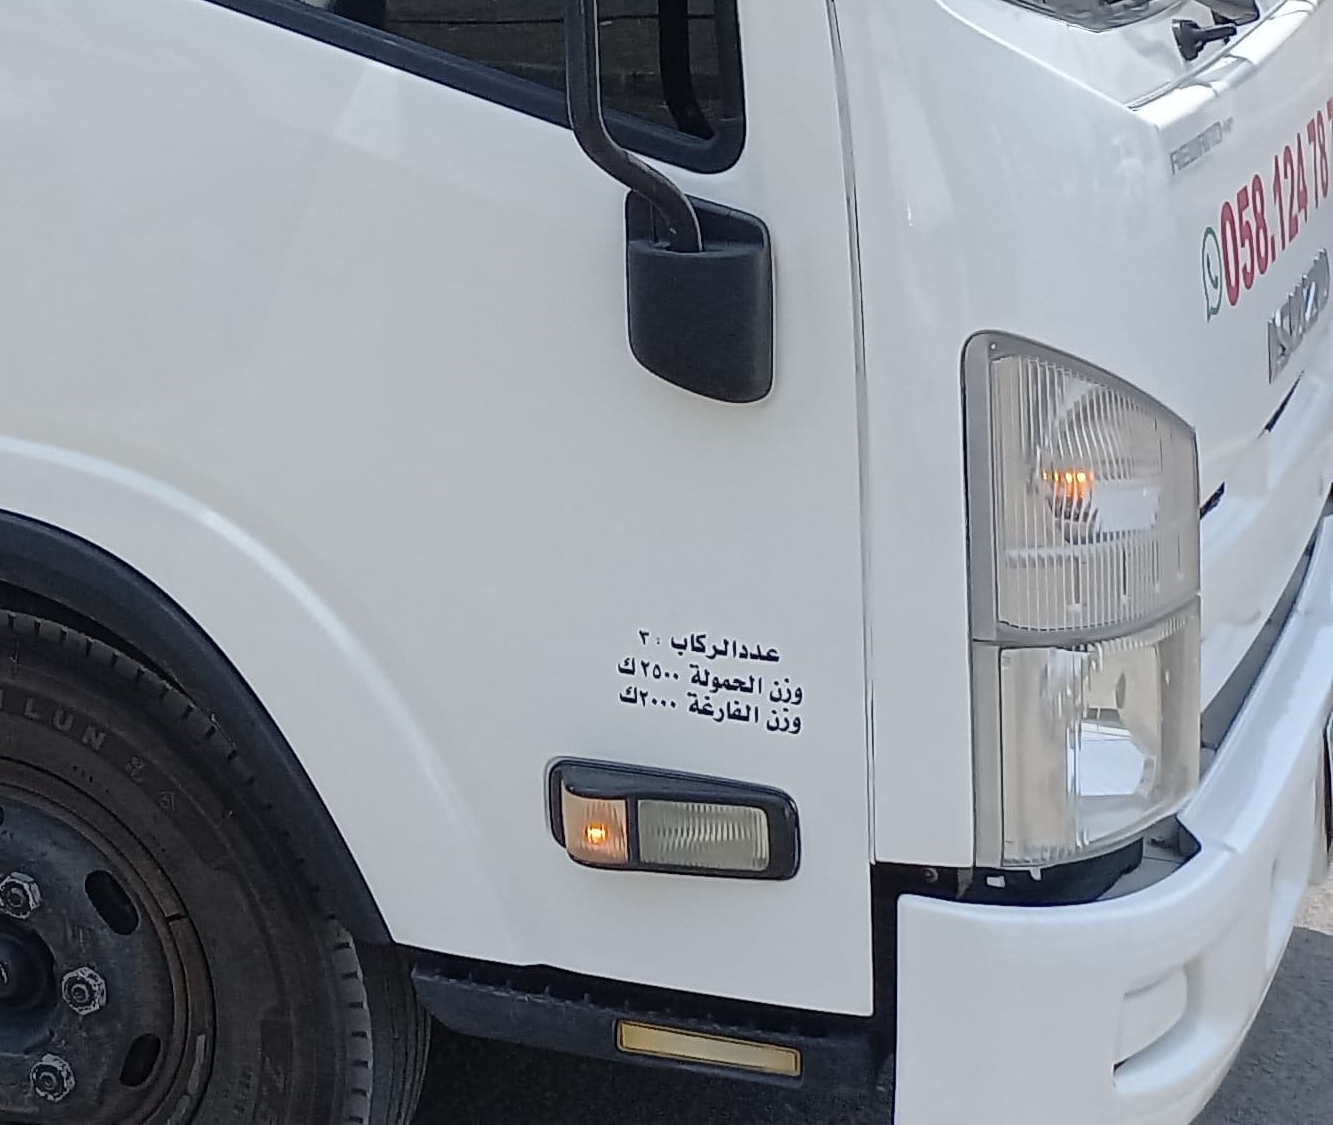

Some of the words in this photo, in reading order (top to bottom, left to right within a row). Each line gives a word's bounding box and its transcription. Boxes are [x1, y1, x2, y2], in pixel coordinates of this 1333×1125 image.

[1220, 131, 1309, 306] 058.124
[690, 664, 762, 695] الحمولة
[769, 678, 803, 706] وزن
[687, 692, 759, 724] الفارغة
[766, 707, 802, 735] وزن
